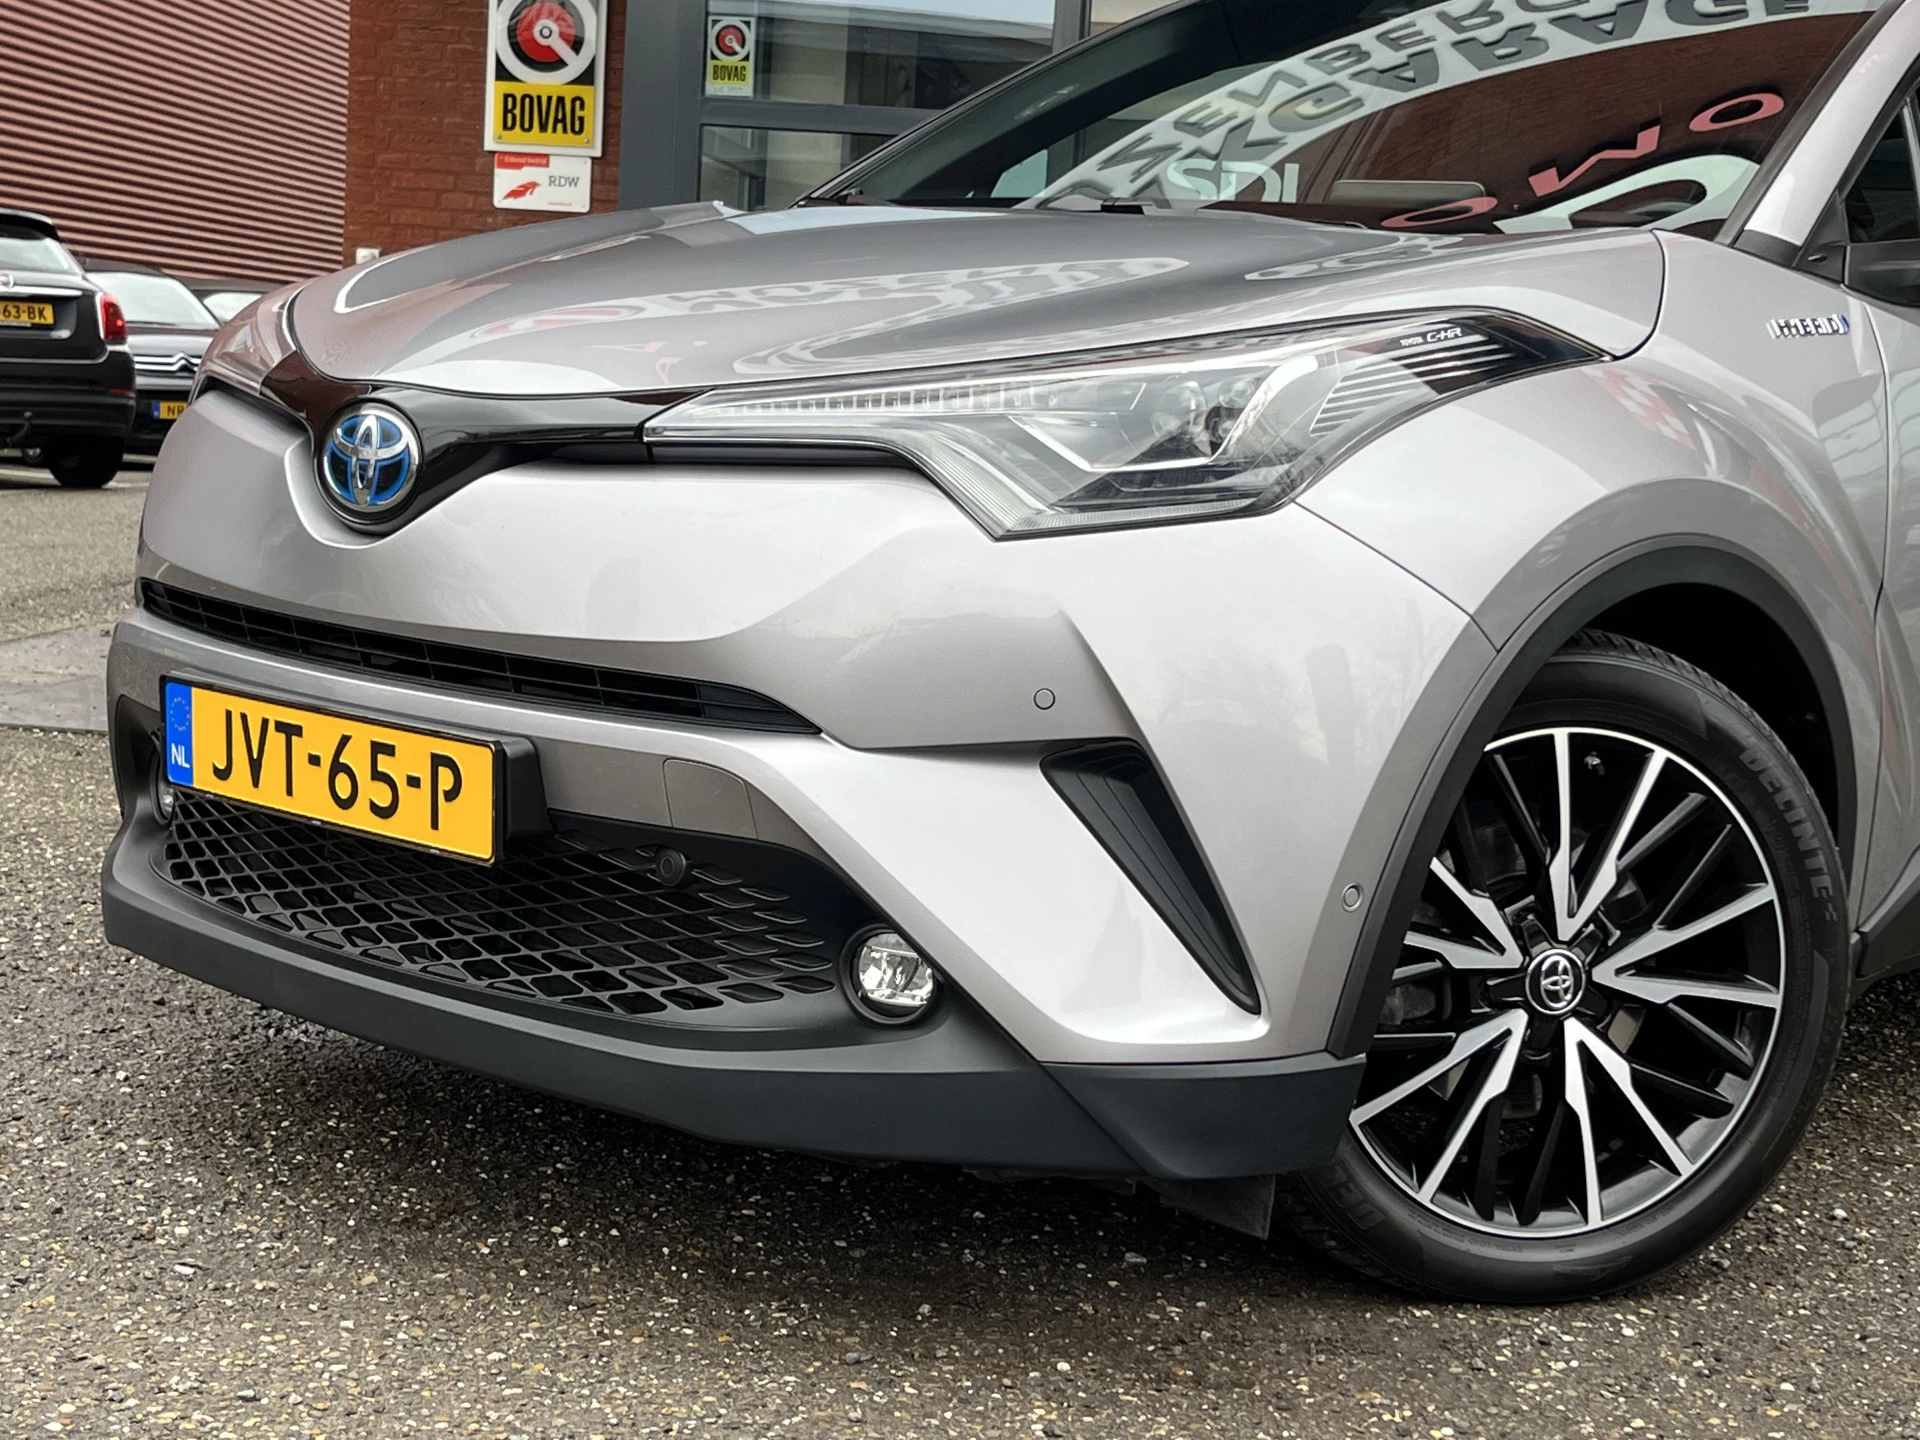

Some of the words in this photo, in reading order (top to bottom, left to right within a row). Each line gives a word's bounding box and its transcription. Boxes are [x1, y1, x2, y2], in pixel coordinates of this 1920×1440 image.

[712, 65, 747, 82] BOVAG
[502, 93, 586, 136] BOVAG
[548, 175, 580, 188] RDW
[1426, 327, 1463, 343] C-HR
[171, 743, 190, 769] NL
[212, 708, 463, 831] JVT-65-P
